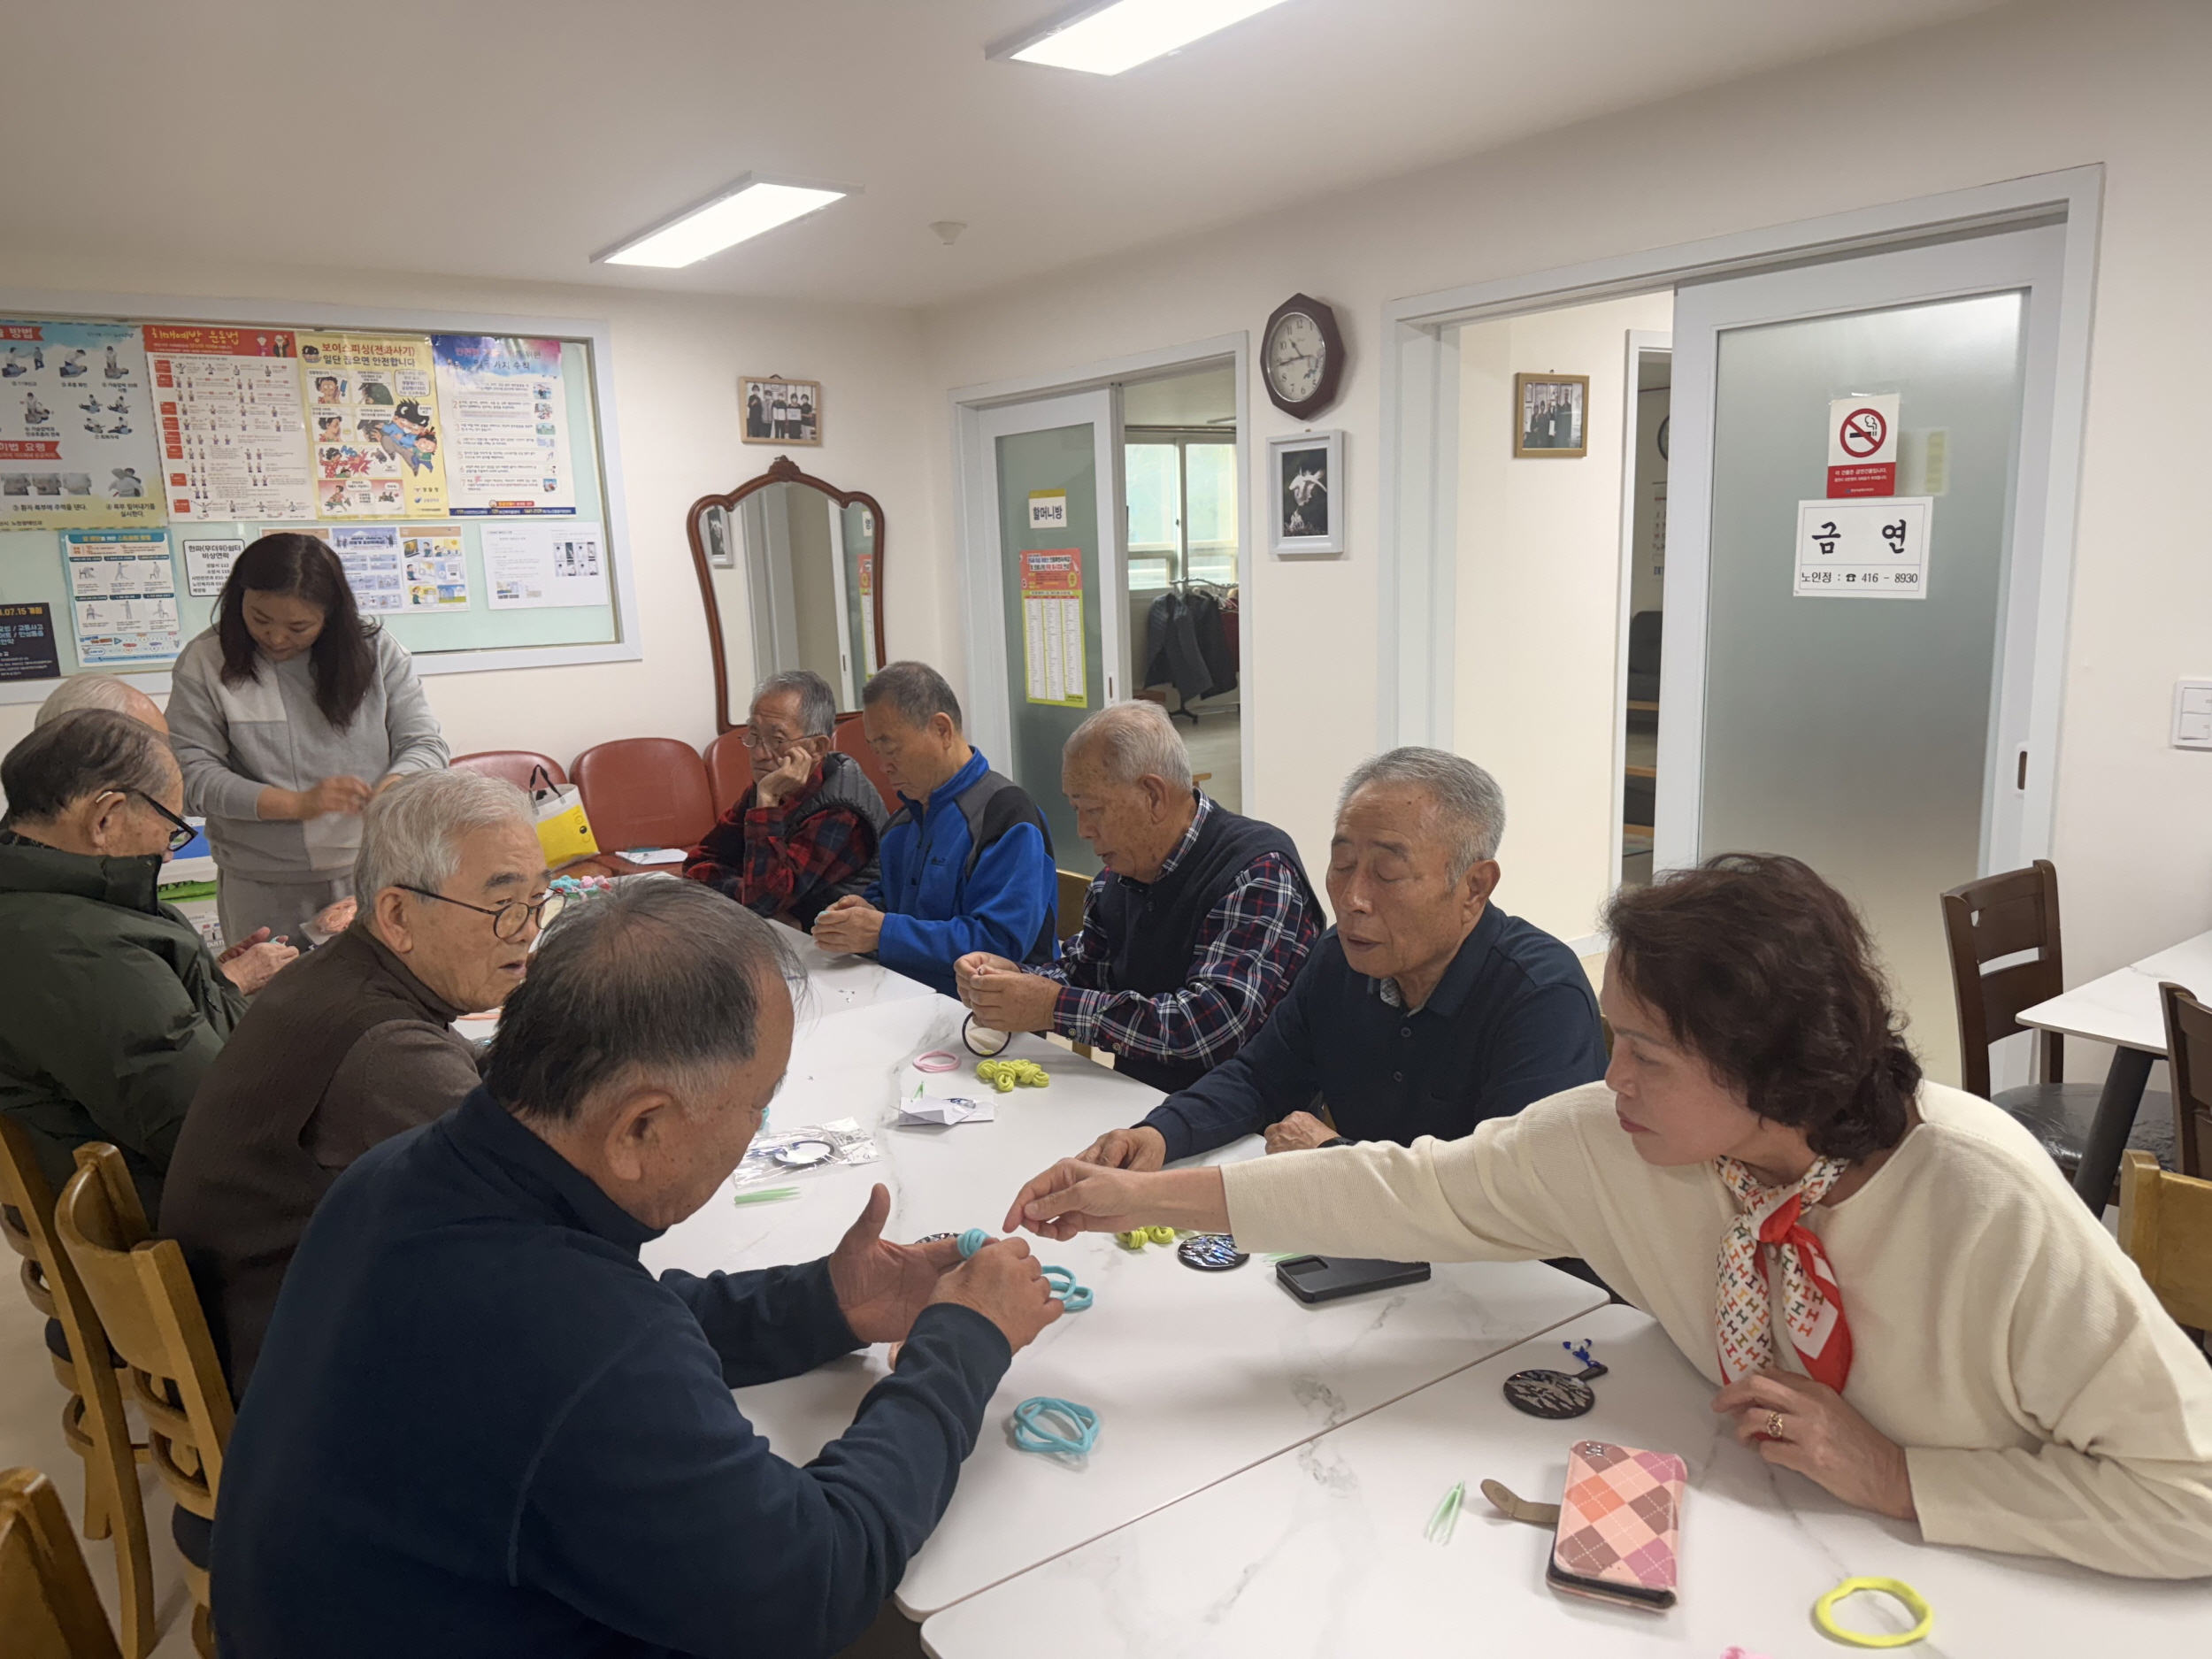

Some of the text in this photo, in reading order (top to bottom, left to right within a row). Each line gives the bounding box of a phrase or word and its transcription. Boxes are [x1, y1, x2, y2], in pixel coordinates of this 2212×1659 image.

[9, 326, 34, 339] 방법
[151, 326, 203, 343] 치매예방
[208, 330, 239, 346] 운동법
[322, 342, 415, 356] 보이스피싱(전화사기)
[1279, 341, 1287, 350] 10
[526, 350, 541, 359] 위한
[323, 355, 415, 367] 일단 끊으면 안전합니다
[494, 360, 511, 370] 가지
[512, 361, 530, 370] 수칙
[1281, 373, 1287, 383] 8
[1301, 385, 1306, 395] 6
[25, 442, 46, 452] 요령
[1033, 505, 1063, 521] 할머니방
[188, 544, 242, 553] 한파(무더위)쉼터
[1801, 572, 1832, 583] 노인정
[1861, 572, 1878, 583] 416
[1894, 572, 1918, 583] 8930
